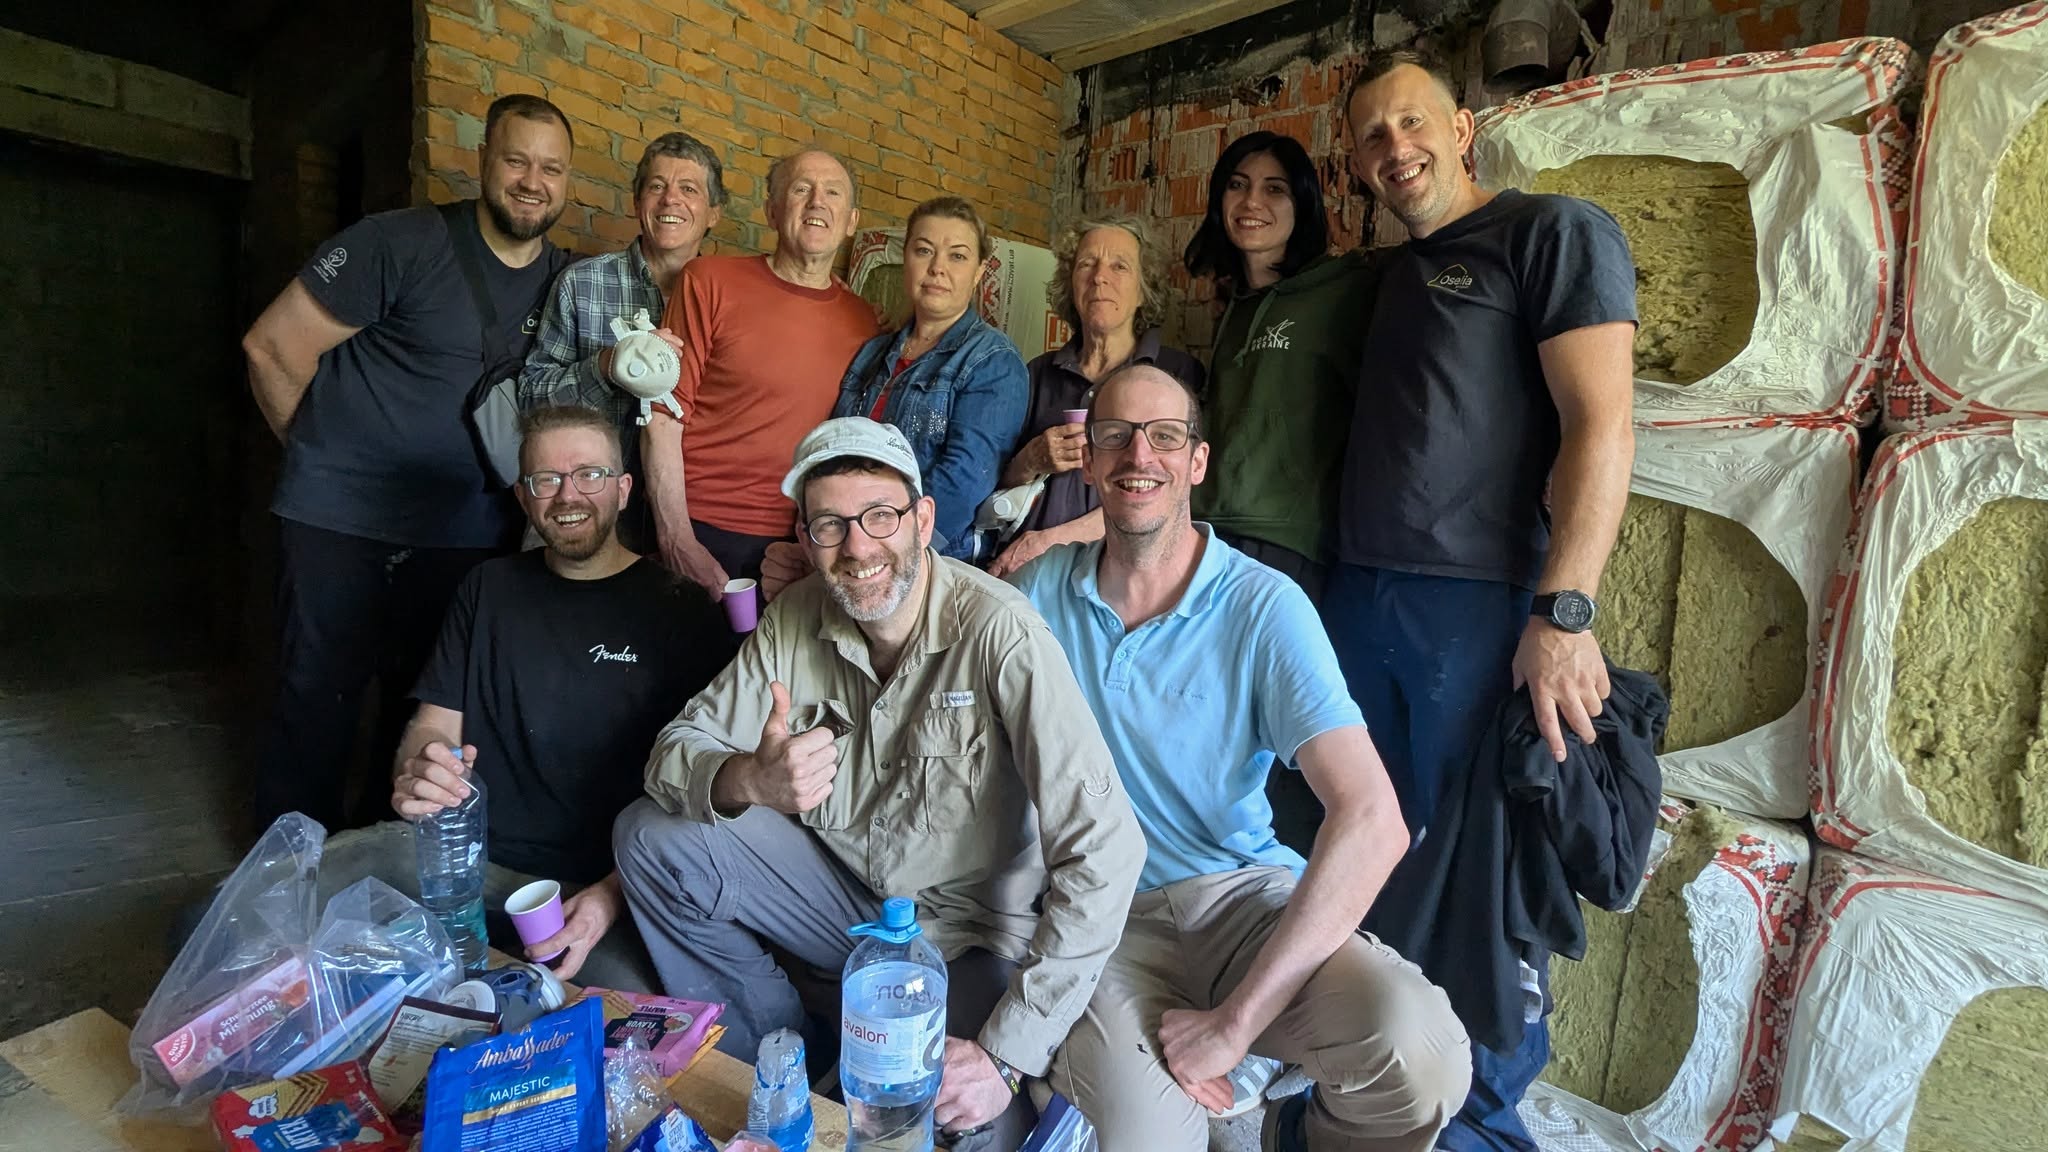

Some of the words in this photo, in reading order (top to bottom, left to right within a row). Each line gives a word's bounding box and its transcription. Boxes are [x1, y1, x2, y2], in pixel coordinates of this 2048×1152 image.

[1440, 275, 1473, 286] Oselia
[589, 644, 637, 663] Fender
[843, 1017, 888, 1044] avalon
[467, 1032, 574, 1074] Ambassador
[489, 1076, 550, 1103] MAJESTIC
